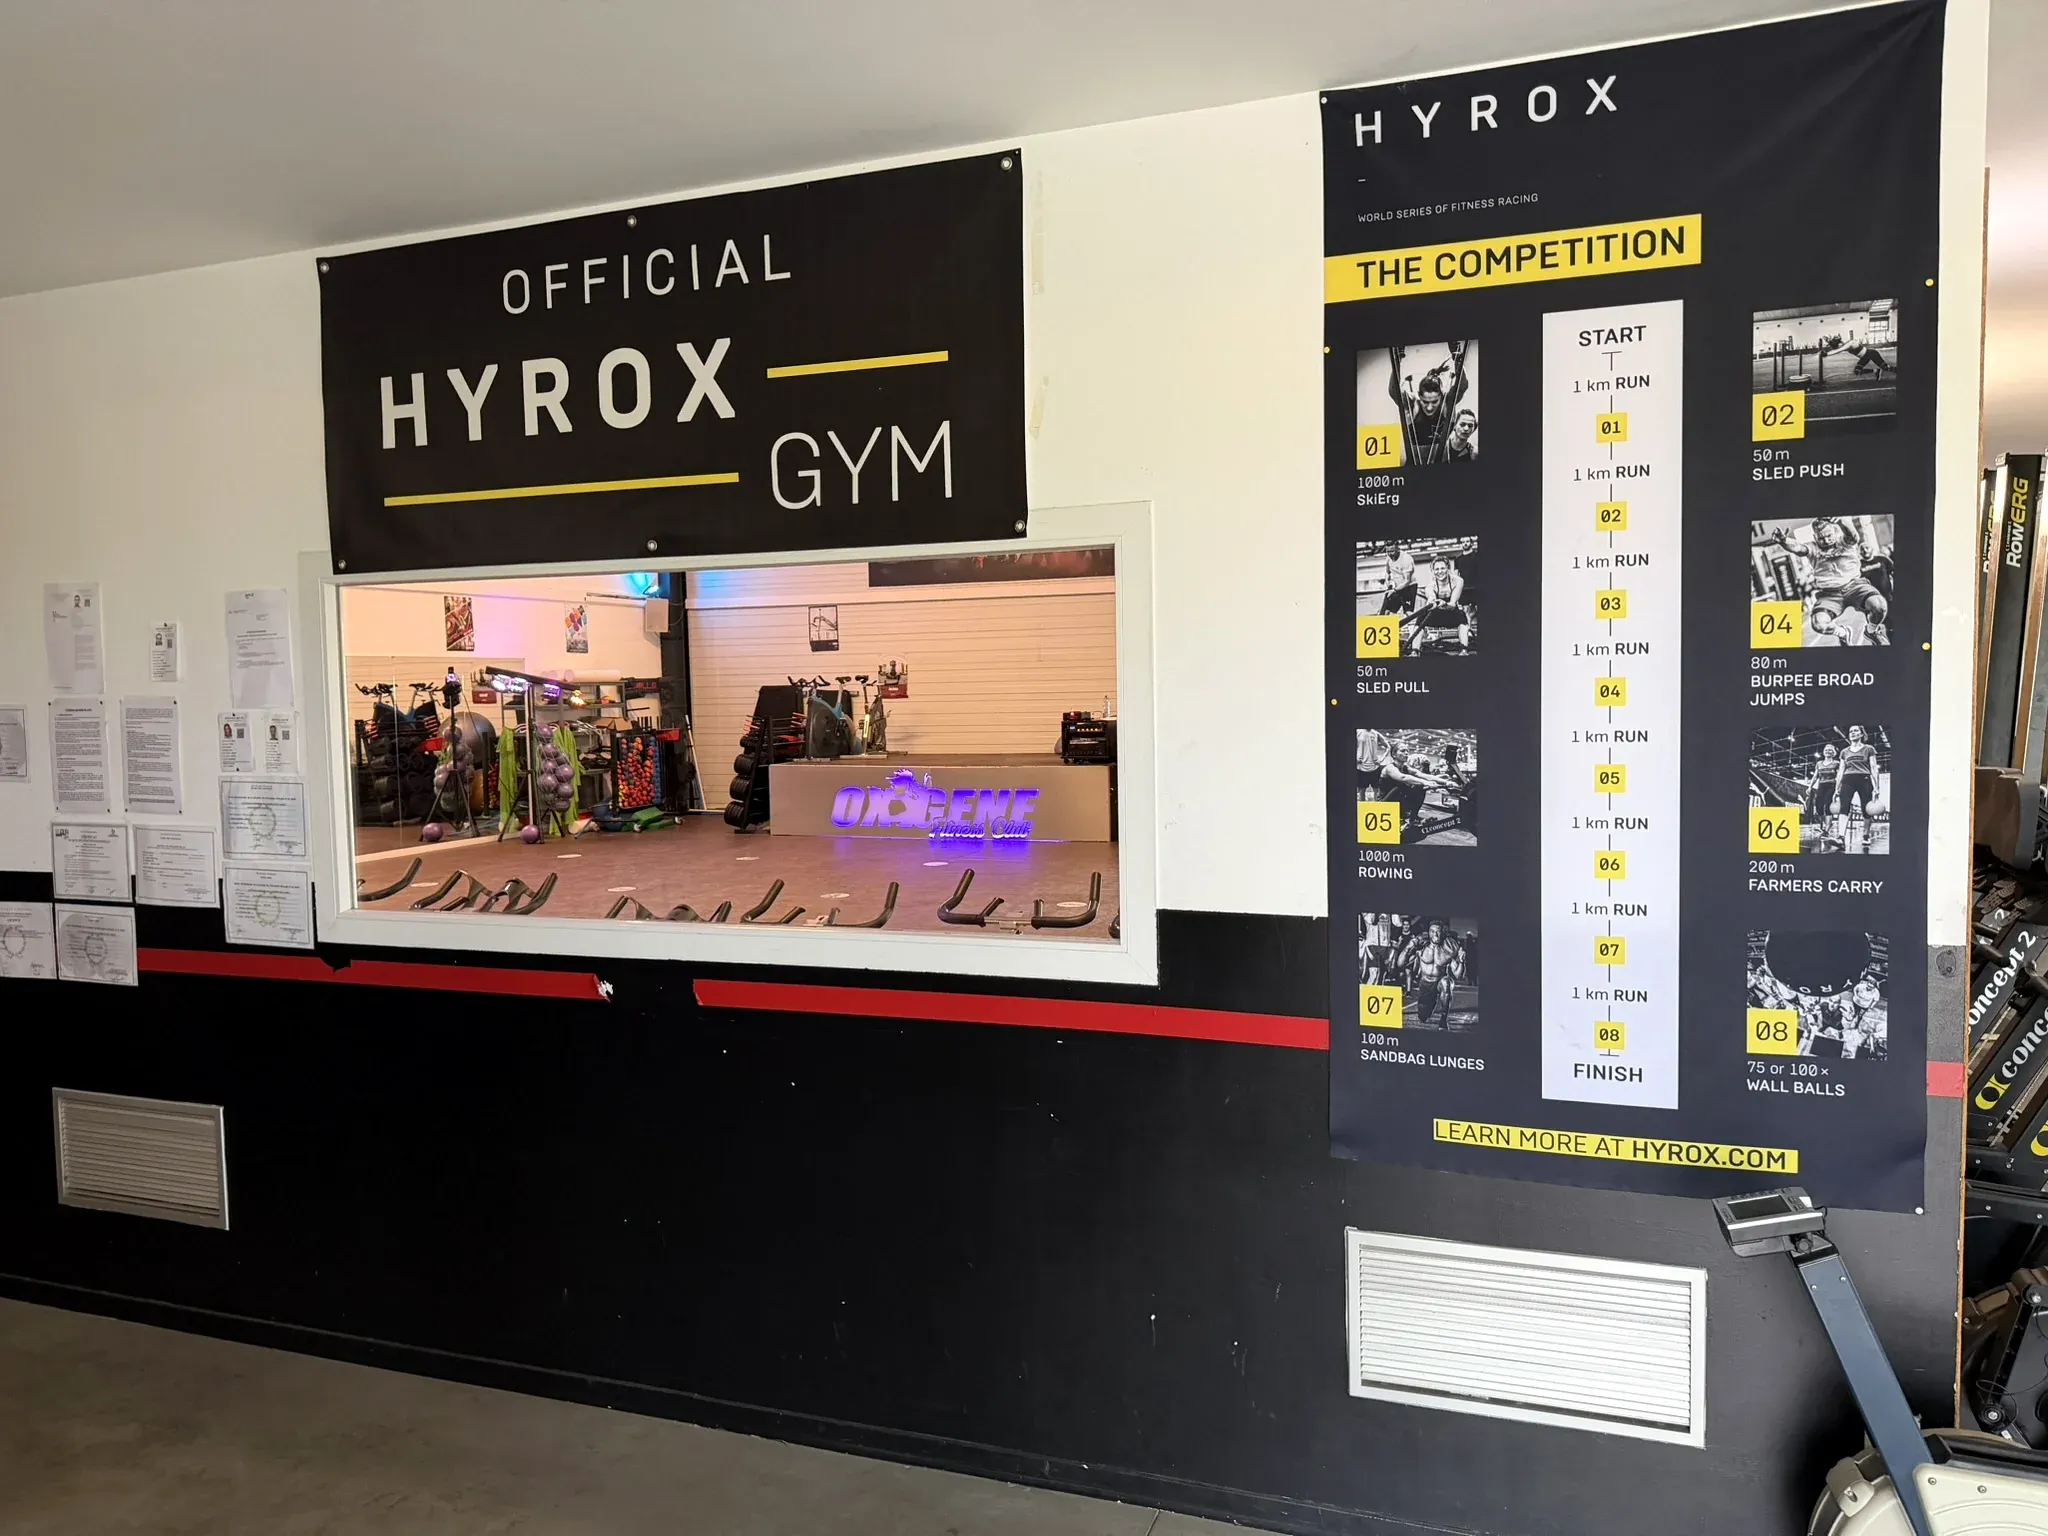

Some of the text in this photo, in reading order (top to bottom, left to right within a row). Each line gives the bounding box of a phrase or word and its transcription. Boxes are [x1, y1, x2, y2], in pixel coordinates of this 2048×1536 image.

[1355, 75, 1617, 147] HYROX
[1357, 193, 1539, 222] WORLD SERIES OF FITNESS RACING
[1357, 226, 1685, 288] THE COMPETITION
[503, 235, 790, 314] OFFICIAL
[1579, 326, 1646, 346] START
[1573, 375, 1650, 392] 1 km RUN
[381, 338, 735, 449] HYROX
[1762, 405, 1795, 426] 02
[1601, 421, 1621, 434] 01
[1365, 437, 1391, 456] 01
[1753, 449, 1790, 462] 50 m
[771, 421, 952, 509] GYM
[1752, 464, 1844, 480] SLED PUSH
[1573, 465, 1650, 481] 1 km RUN
[1357, 476, 1405, 488] 1000 m
[1357, 493, 1400, 505] SkiErg
[1601, 509, 1621, 522] 02
[1572, 554, 1649, 568] 1 km RUN
[1600, 597, 1621, 610] 03
[1760, 614, 1793, 634] 04
[1363, 627, 1391, 645] 03
[1572, 642, 1649, 655] 1 km RUN
[1750, 657, 1787, 669] 80 m
[1357, 666, 1388, 676] 50 m
[1356, 682, 1430, 693] SLED PULL
[1752, 673, 1874, 687] BURPEE BROAD
[1600, 685, 1621, 697] 04
[1749, 693, 1805, 705] JUMPS
[1571, 731, 1648, 742] 1 km RUN
[1599, 772, 1620, 784] 05
[928, 815, 1032, 838] Fitness Club
[1364, 813, 1392, 831] 05
[1572, 817, 1648, 829] 1 km RUN
[1758, 820, 1790, 839] 06
[1358, 851, 1405, 862] 1000 m
[1599, 858, 1620, 870] 06
[1358, 867, 1413, 879] ROWING
[1749, 861, 1795, 873] 200 m
[1750, 879, 1884, 893] FARMERS CARRY
[1571, 903, 1647, 916] 1 km RUN
[1599, 944, 1620, 956] 07
[1968, 930, 2037, 1035] oncept 2
[1572, 987, 1648, 1002] 1 km RUN
[1367, 996, 1394, 1014] 07
[1599, 1029, 1620, 1041] 08
[1756, 1021, 1788, 1041] 08
[1361, 1033, 1399, 1046] 100 m
[2002, 1007, 2048, 1078] conc
[1361, 1049, 1485, 1070] SANDBAG LUNGES
[1575, 1064, 1642, 1082] FINISH
[1747, 1061, 1766, 1073] 75
[1770, 1065, 1785, 1074] or
[1789, 1064, 1818, 1076] 100
[1746, 1079, 1845, 1096] WALL BALLS
[1435, 1121, 1786, 1170] LEARN MORE AT HYROX.COM
